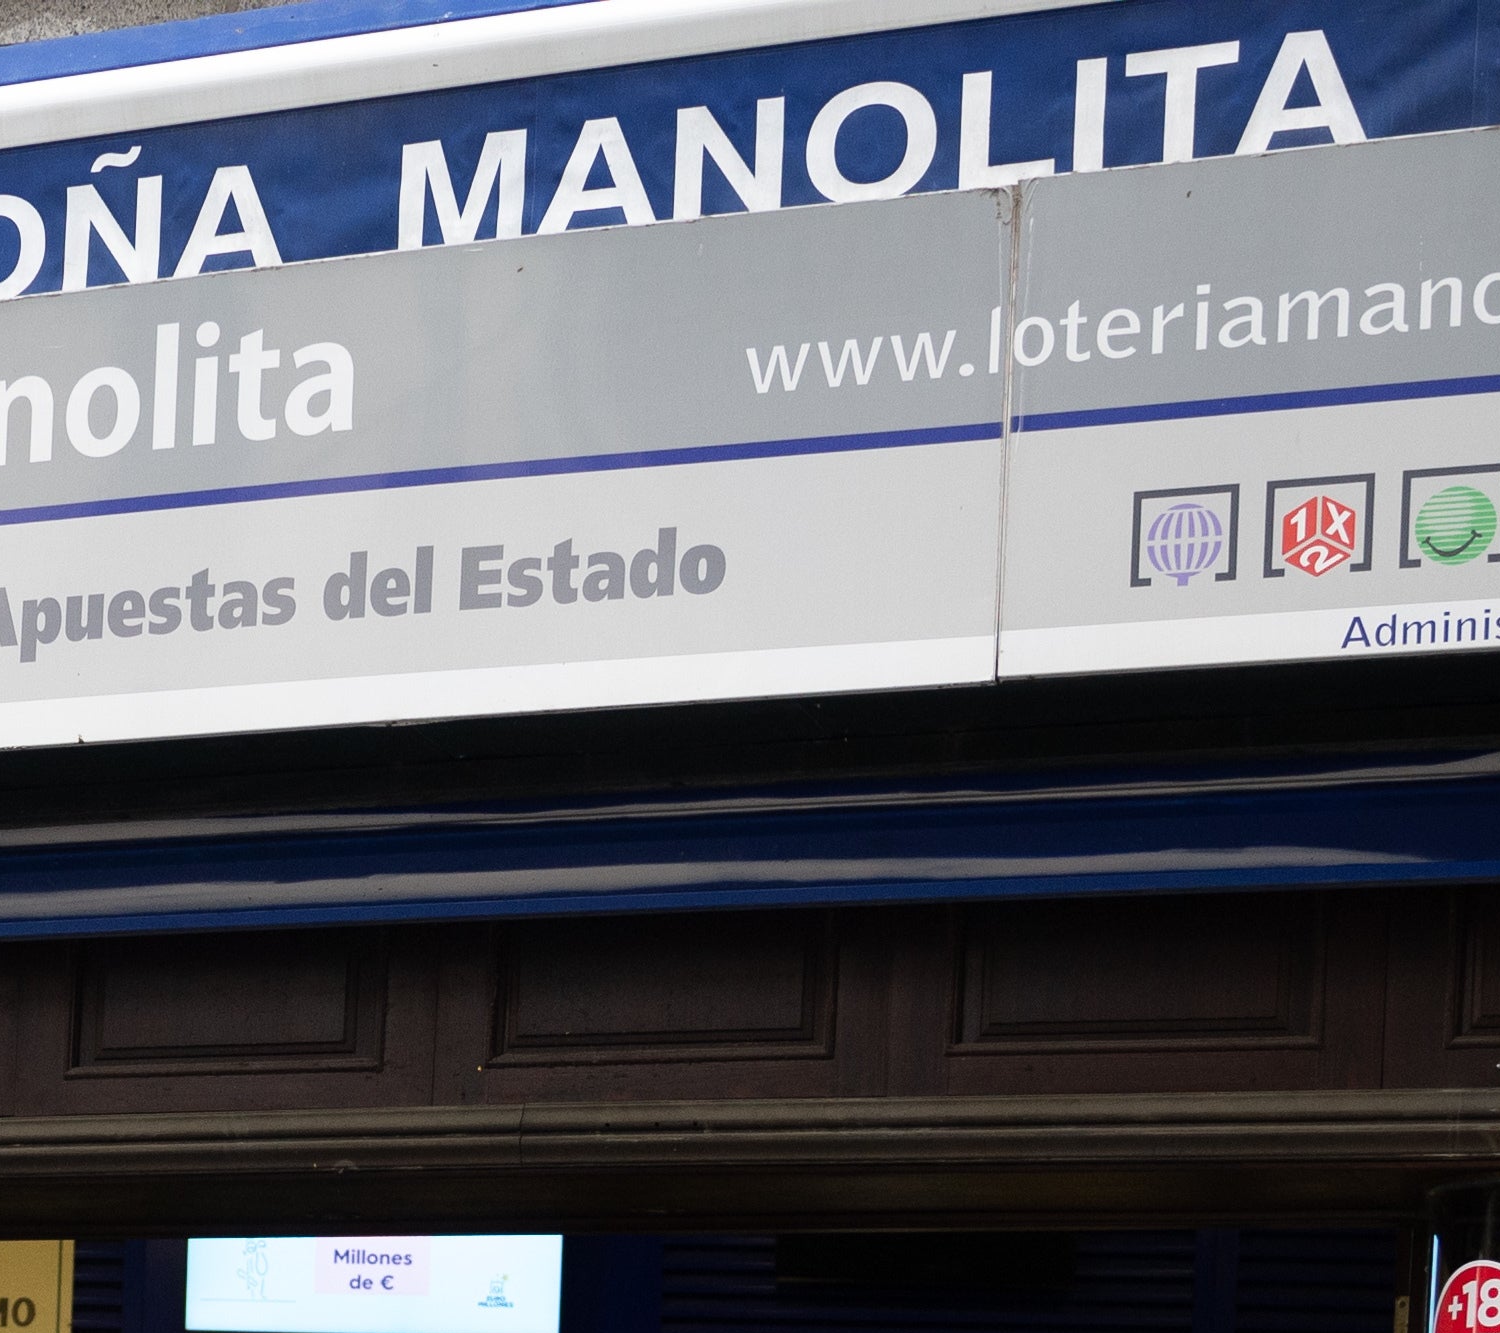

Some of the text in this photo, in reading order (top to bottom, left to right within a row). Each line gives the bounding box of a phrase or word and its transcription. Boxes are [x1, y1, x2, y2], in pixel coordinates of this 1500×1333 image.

[398, 29, 1367, 251] MANOLITA
[322, 544, 435, 622] del
[458, 525, 727, 613] Estado
[333, 1248, 413, 1266] Millones
[349, 1274, 394, 1290] de €
